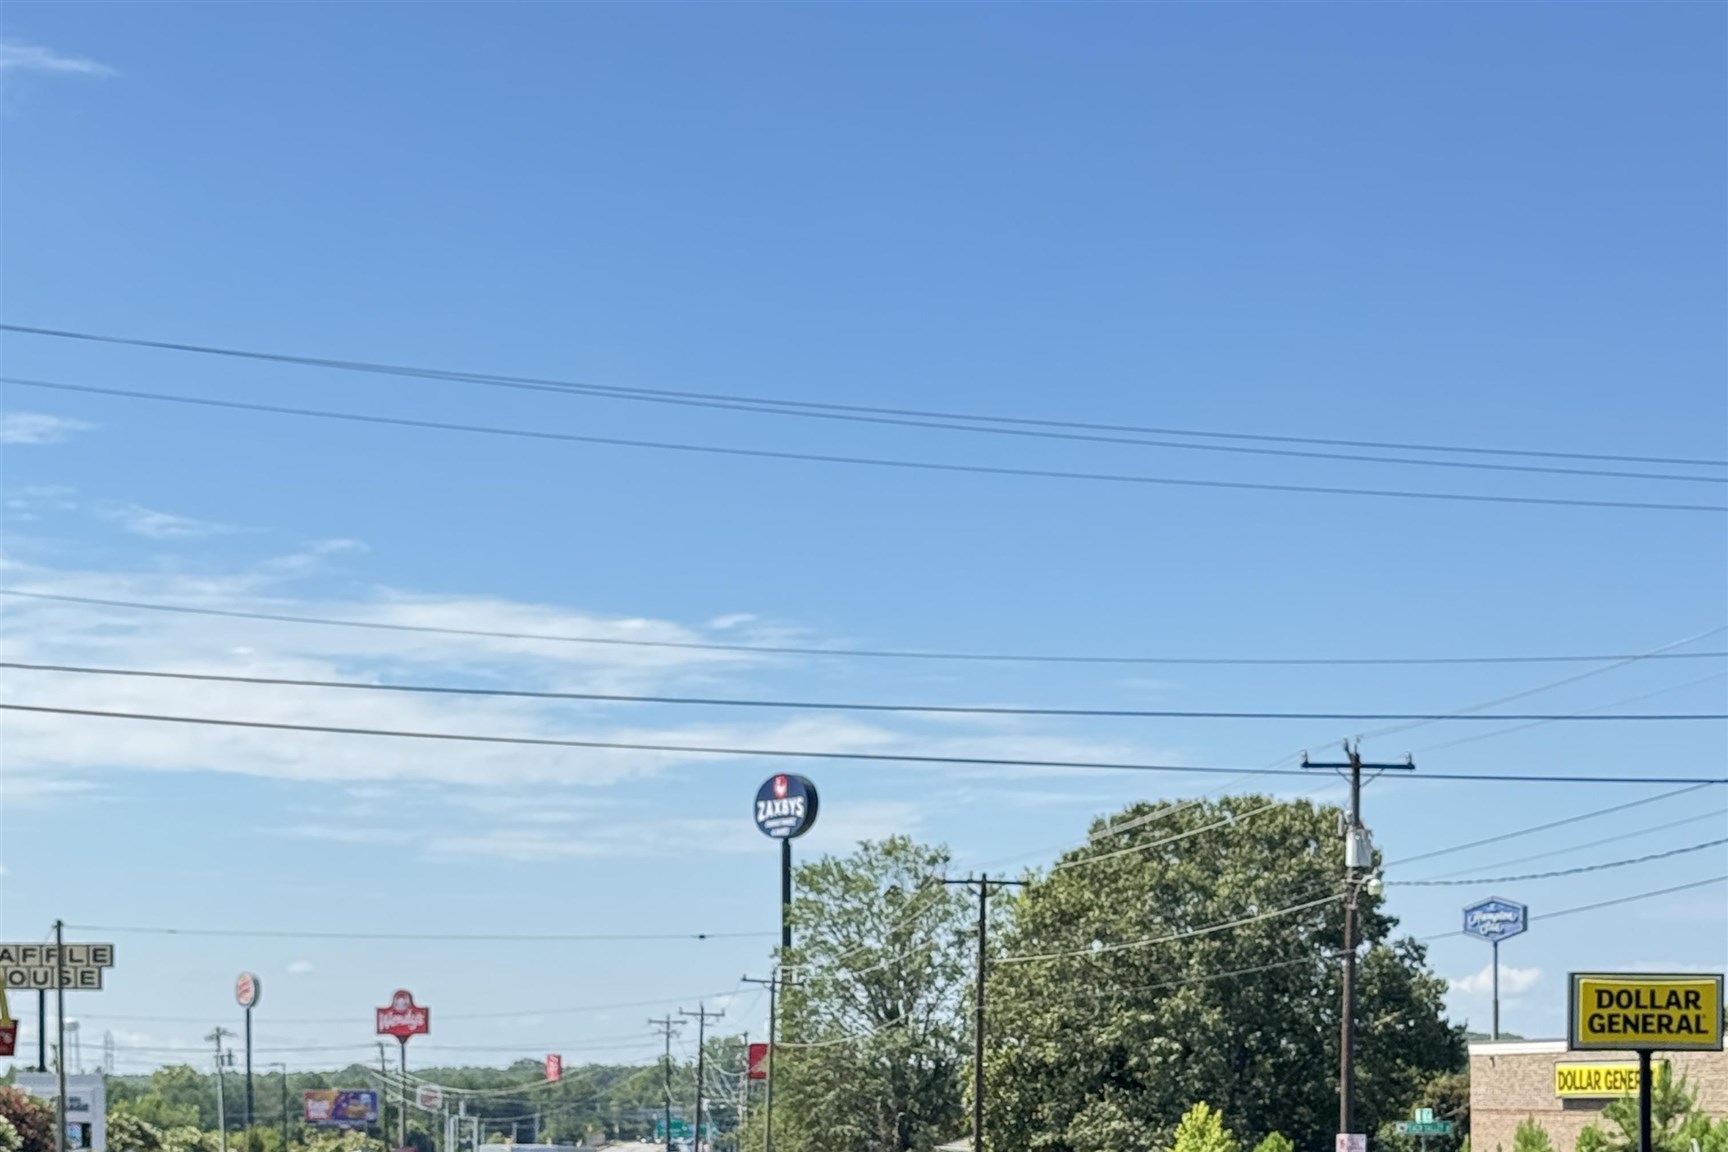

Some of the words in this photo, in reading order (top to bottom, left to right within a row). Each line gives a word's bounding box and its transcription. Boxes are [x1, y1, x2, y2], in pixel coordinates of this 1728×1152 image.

[757, 796, 805, 822] ZAXBYS
[1594, 988, 1702, 1010] DOLLAR
[1587, 1012, 1709, 1035] GENERAL
[1557, 1070, 1601, 1091] DOLLAR
[1604, 1070, 1652, 1091] GENER
